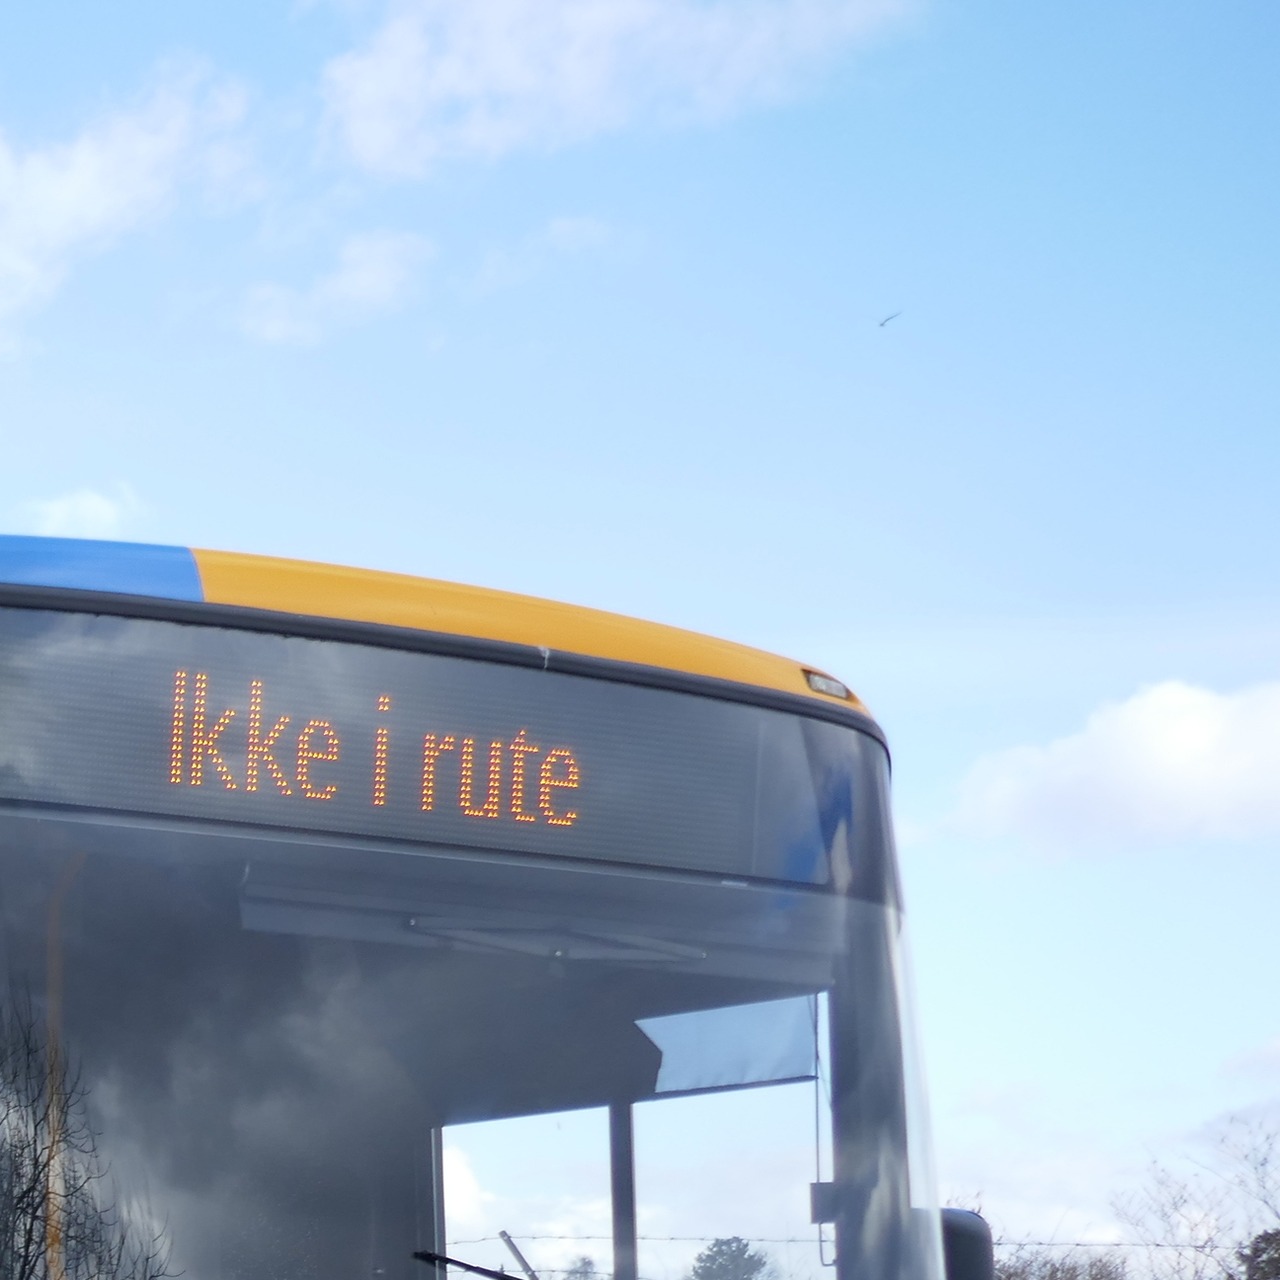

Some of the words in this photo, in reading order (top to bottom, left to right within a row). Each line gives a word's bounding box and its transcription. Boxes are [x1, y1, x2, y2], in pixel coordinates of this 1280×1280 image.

[169, 671, 339, 799] Ikke
[373, 694, 391, 807] i
[421, 728, 581, 827] rute
